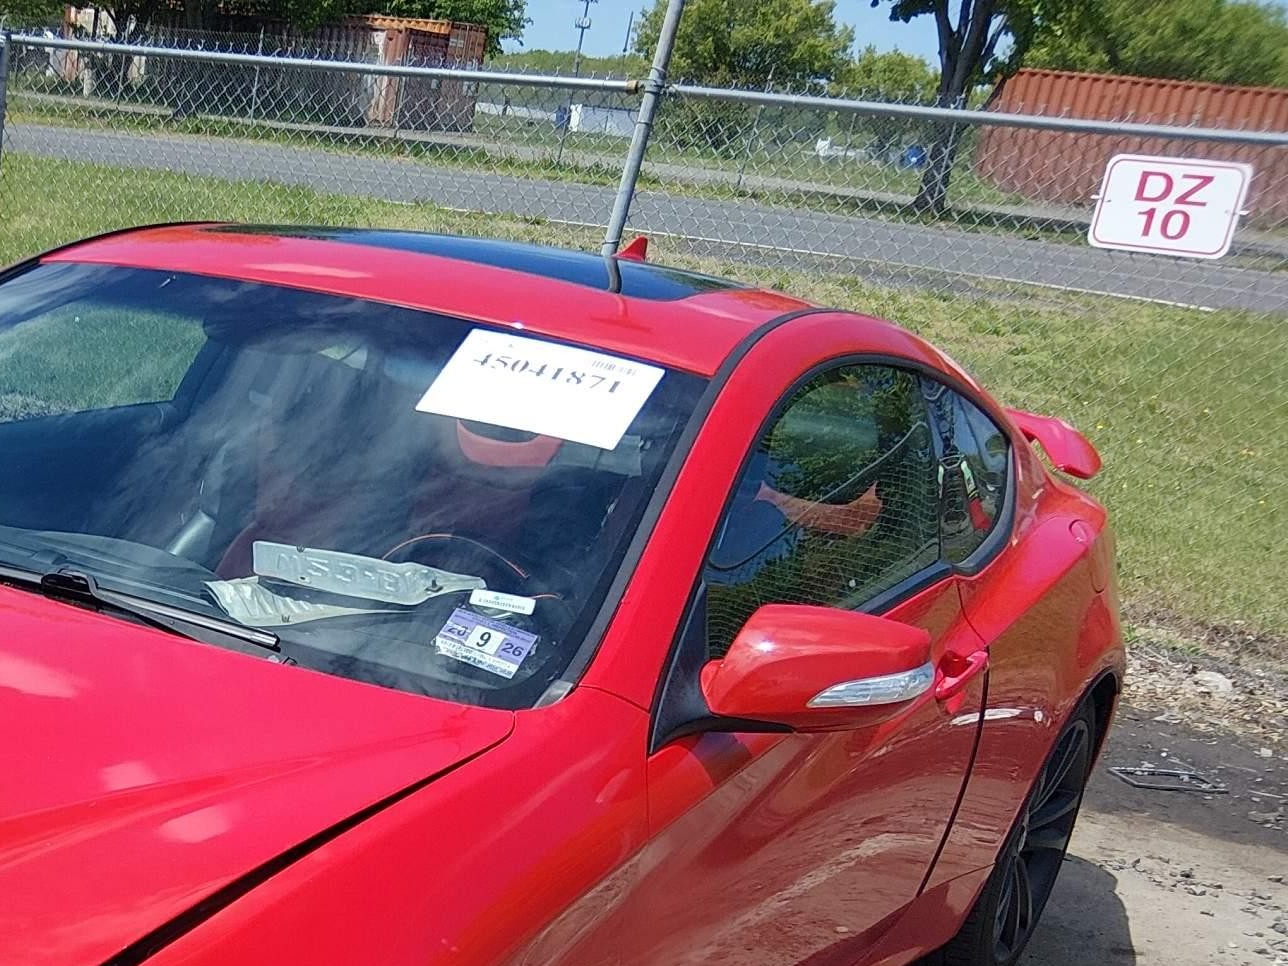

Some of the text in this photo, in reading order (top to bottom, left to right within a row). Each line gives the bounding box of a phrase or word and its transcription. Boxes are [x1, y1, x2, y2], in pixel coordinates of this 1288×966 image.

[1134, 170, 1215, 207] DZ
[1137, 207, 1191, 240] 10
[473, 353, 622, 393] 45041871
[476, 631, 492, 648] 9
[501, 642, 524, 657] 26
